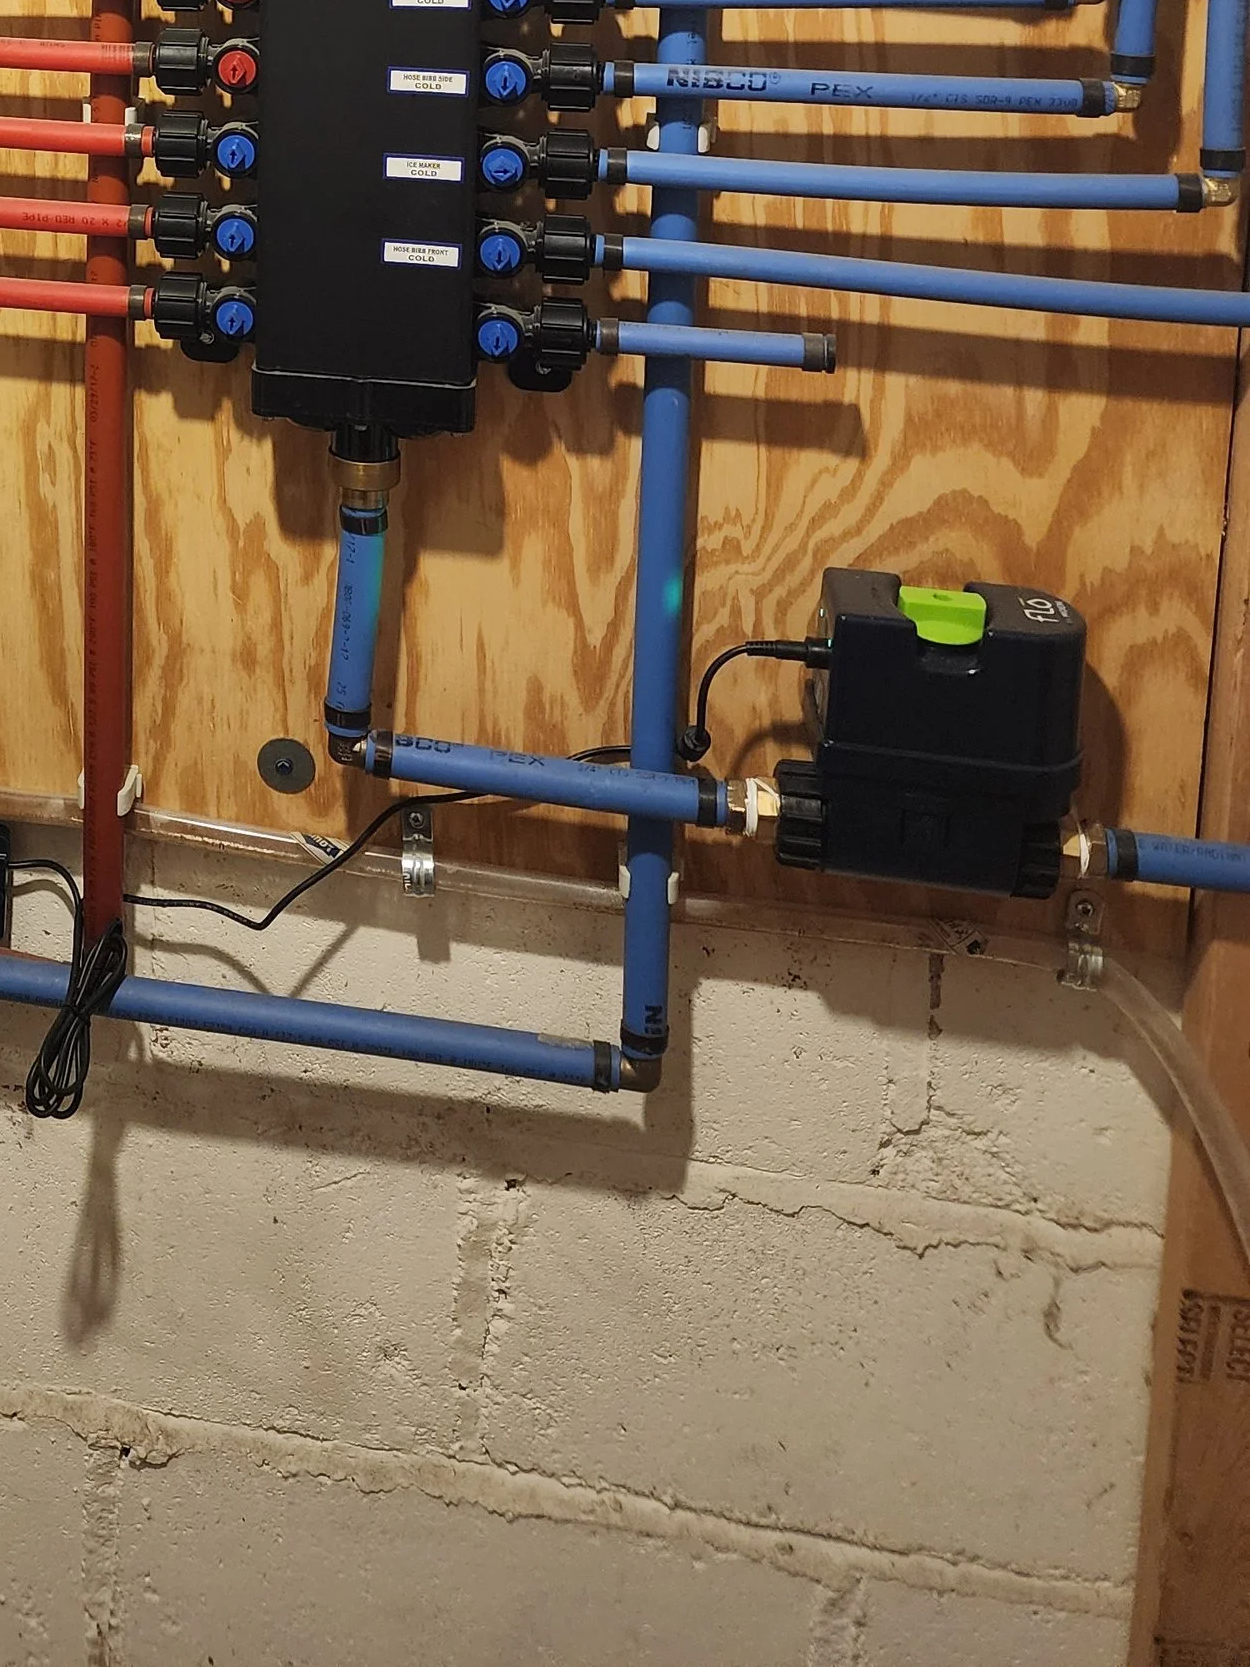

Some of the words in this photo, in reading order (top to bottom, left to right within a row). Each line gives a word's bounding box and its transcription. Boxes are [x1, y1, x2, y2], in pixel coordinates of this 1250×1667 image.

[810, 81, 874, 99] PEX
[411, 169, 438, 177] COLD
[428, 248, 449, 256] FRONT
[408, 255, 434, 263] COLD
